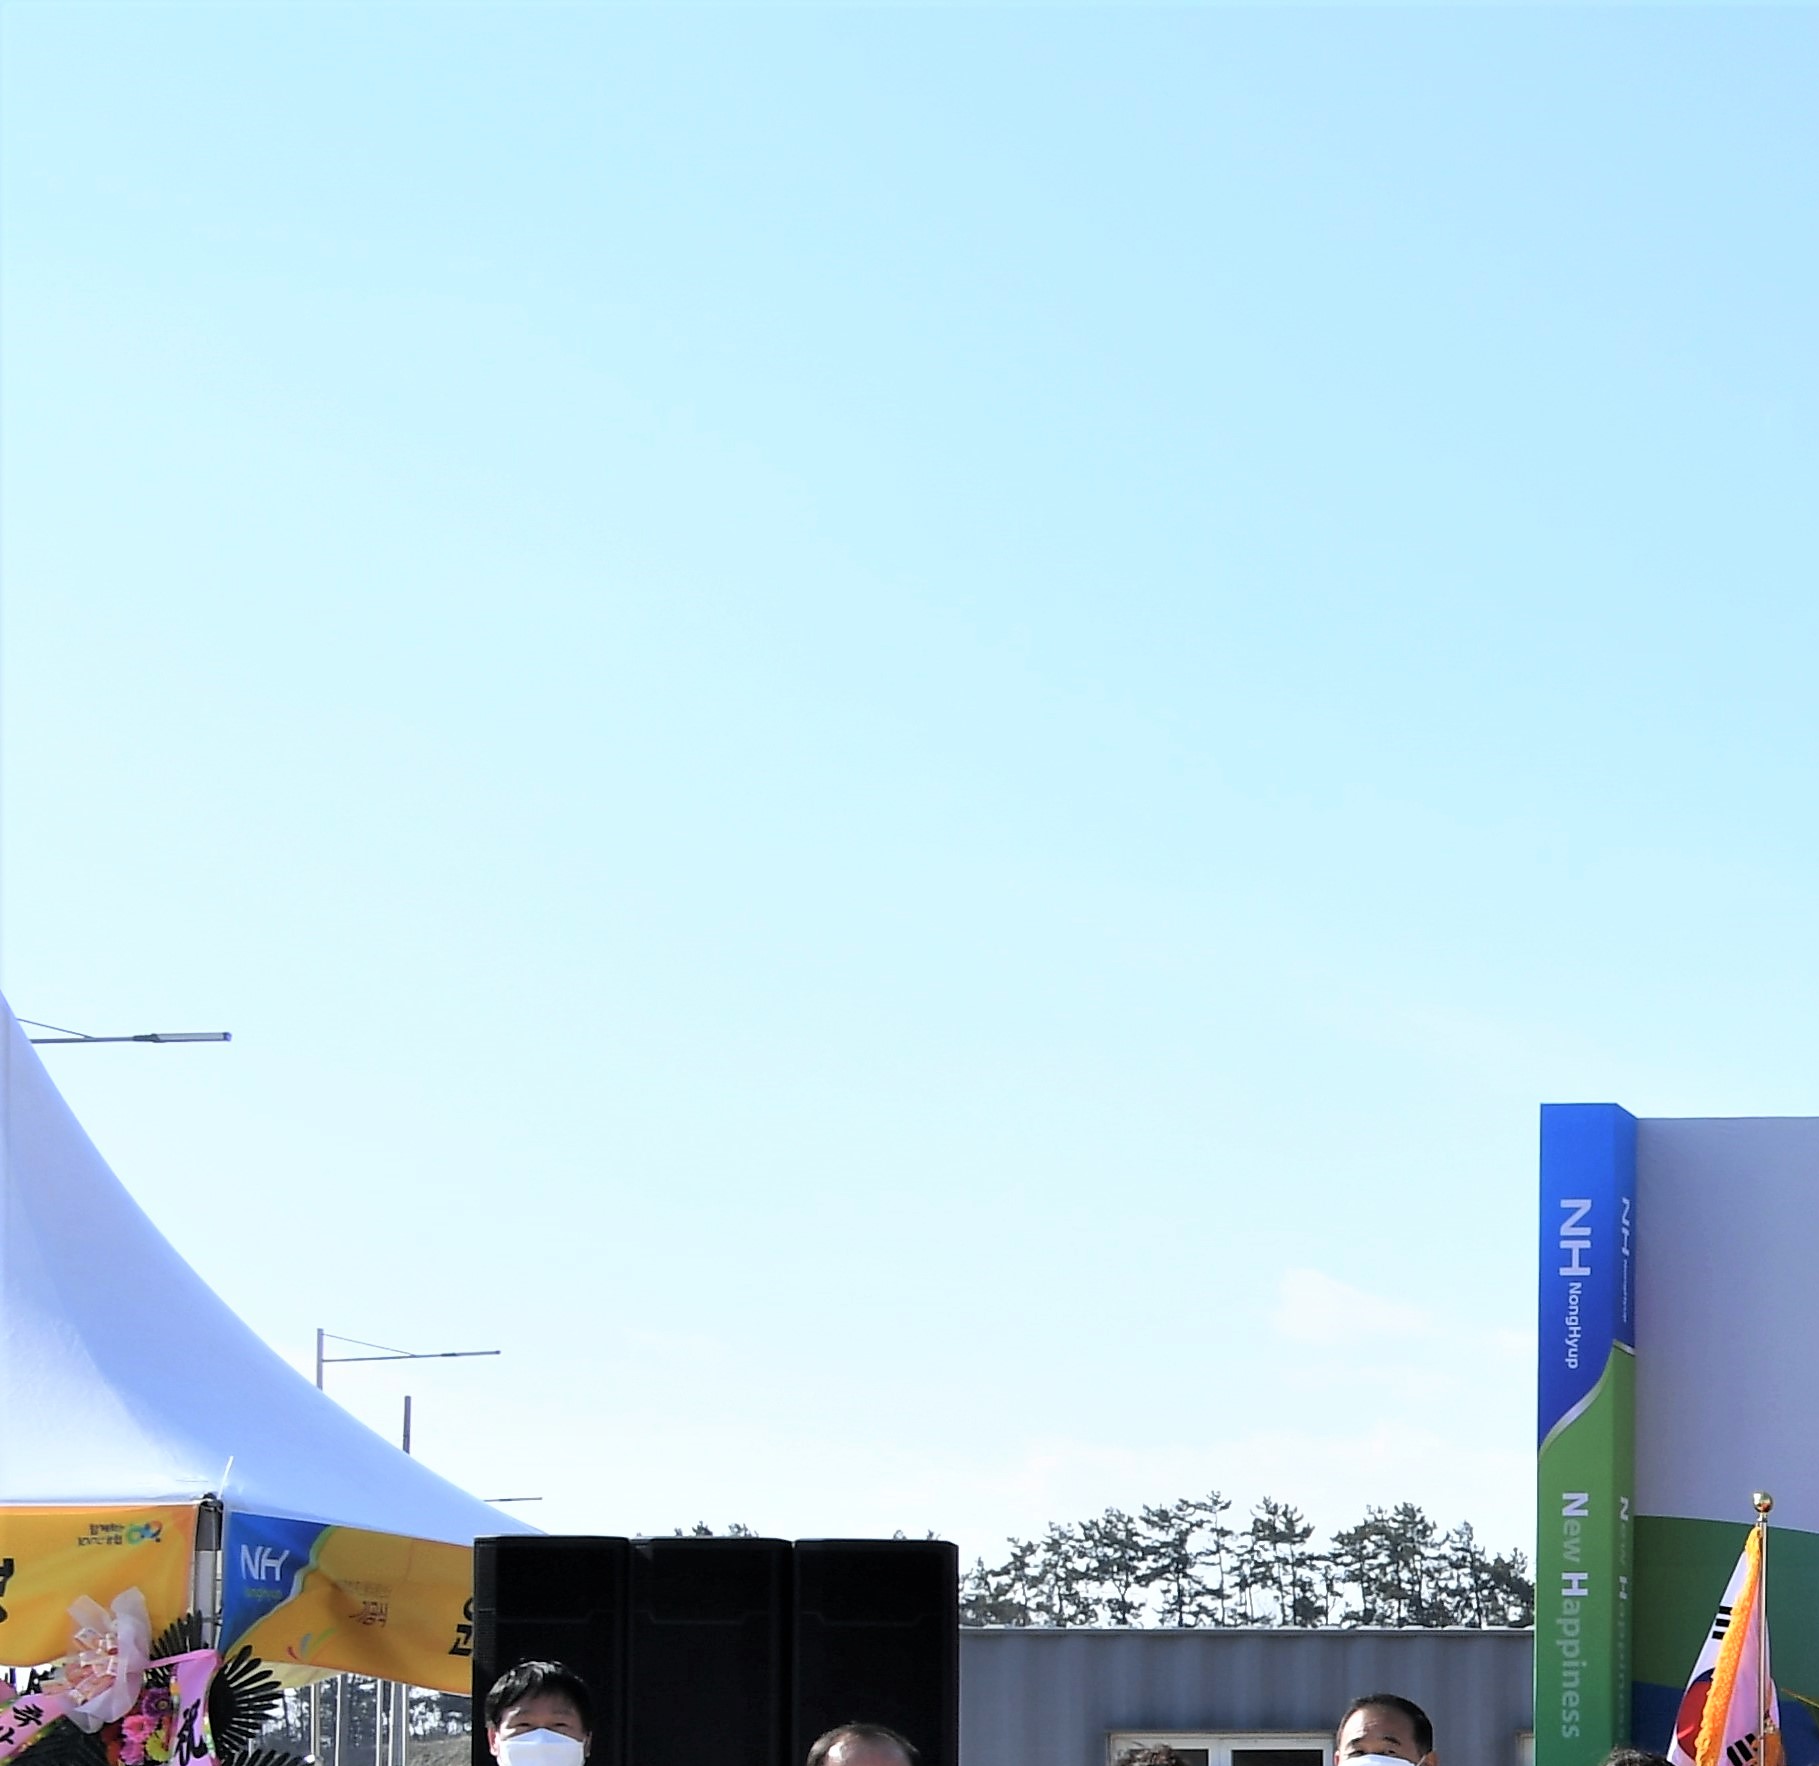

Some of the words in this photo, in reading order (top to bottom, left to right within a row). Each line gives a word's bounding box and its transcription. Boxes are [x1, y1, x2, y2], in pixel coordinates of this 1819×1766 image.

[1559, 1198, 1592, 1276] NH
[1565, 1282, 1582, 1369] NongHyup
[241, 1544, 290, 1581] NH
[1562, 1492, 1589, 1563] New
[1556, 1572, 1589, 1738] Happiness
